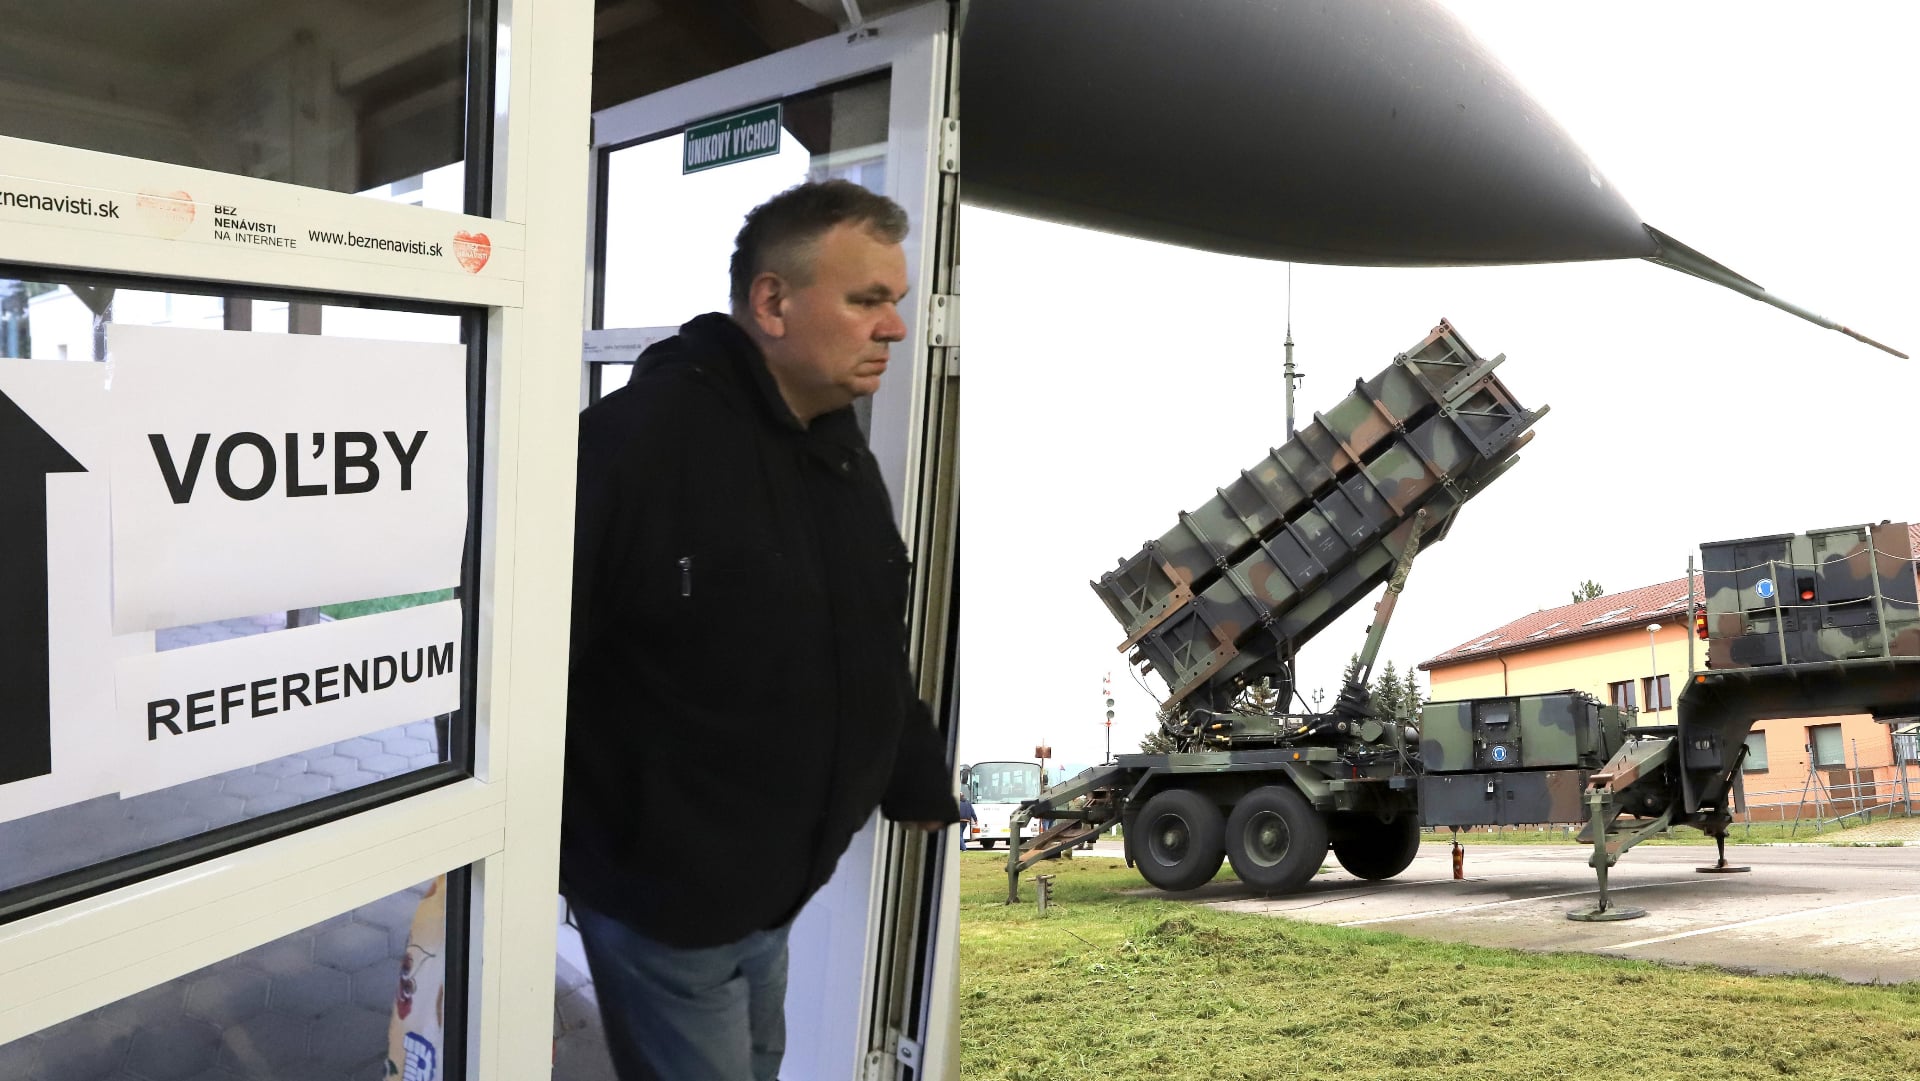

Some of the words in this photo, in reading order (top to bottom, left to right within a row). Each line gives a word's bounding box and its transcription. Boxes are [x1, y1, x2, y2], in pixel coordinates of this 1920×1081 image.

[687, 124, 731, 166] ÚNIKOVÝ
[733, 119, 777, 155] VÝCHOD
[214, 204, 237, 216] BEZ
[214, 217, 276, 234] NENÁVISTI
[214, 229, 231, 241] NA
[235, 232, 297, 249] INTERNETE
[308, 229, 443, 257] www.beznenavisti.sk
[147, 430, 429, 504] VOĽBY
[147, 641, 455, 741] REFERENDUM
